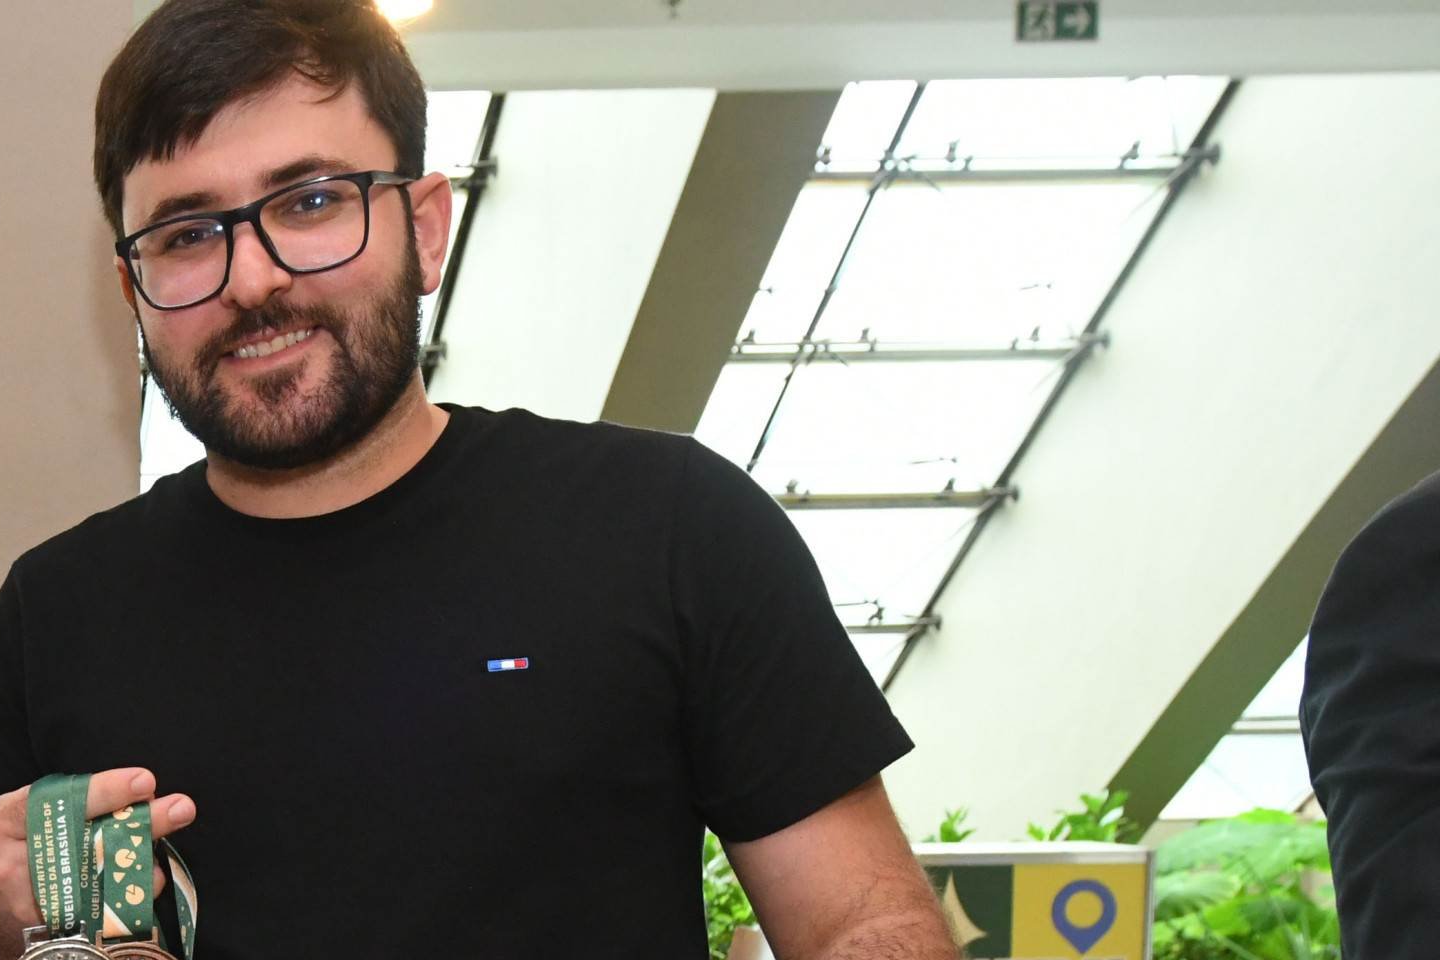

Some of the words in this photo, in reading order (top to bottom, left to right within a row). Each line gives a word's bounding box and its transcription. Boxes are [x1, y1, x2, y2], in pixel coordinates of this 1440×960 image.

[33, 834, 42, 849] DE
[56, 815, 71, 875] BRASÍLIA
[34, 851, 47, 906] DISTRITAL
[49, 863, 58, 881] DA
[50, 884, 60, 935] ESANAIS
[62, 877, 75, 931] QUEIJOS
